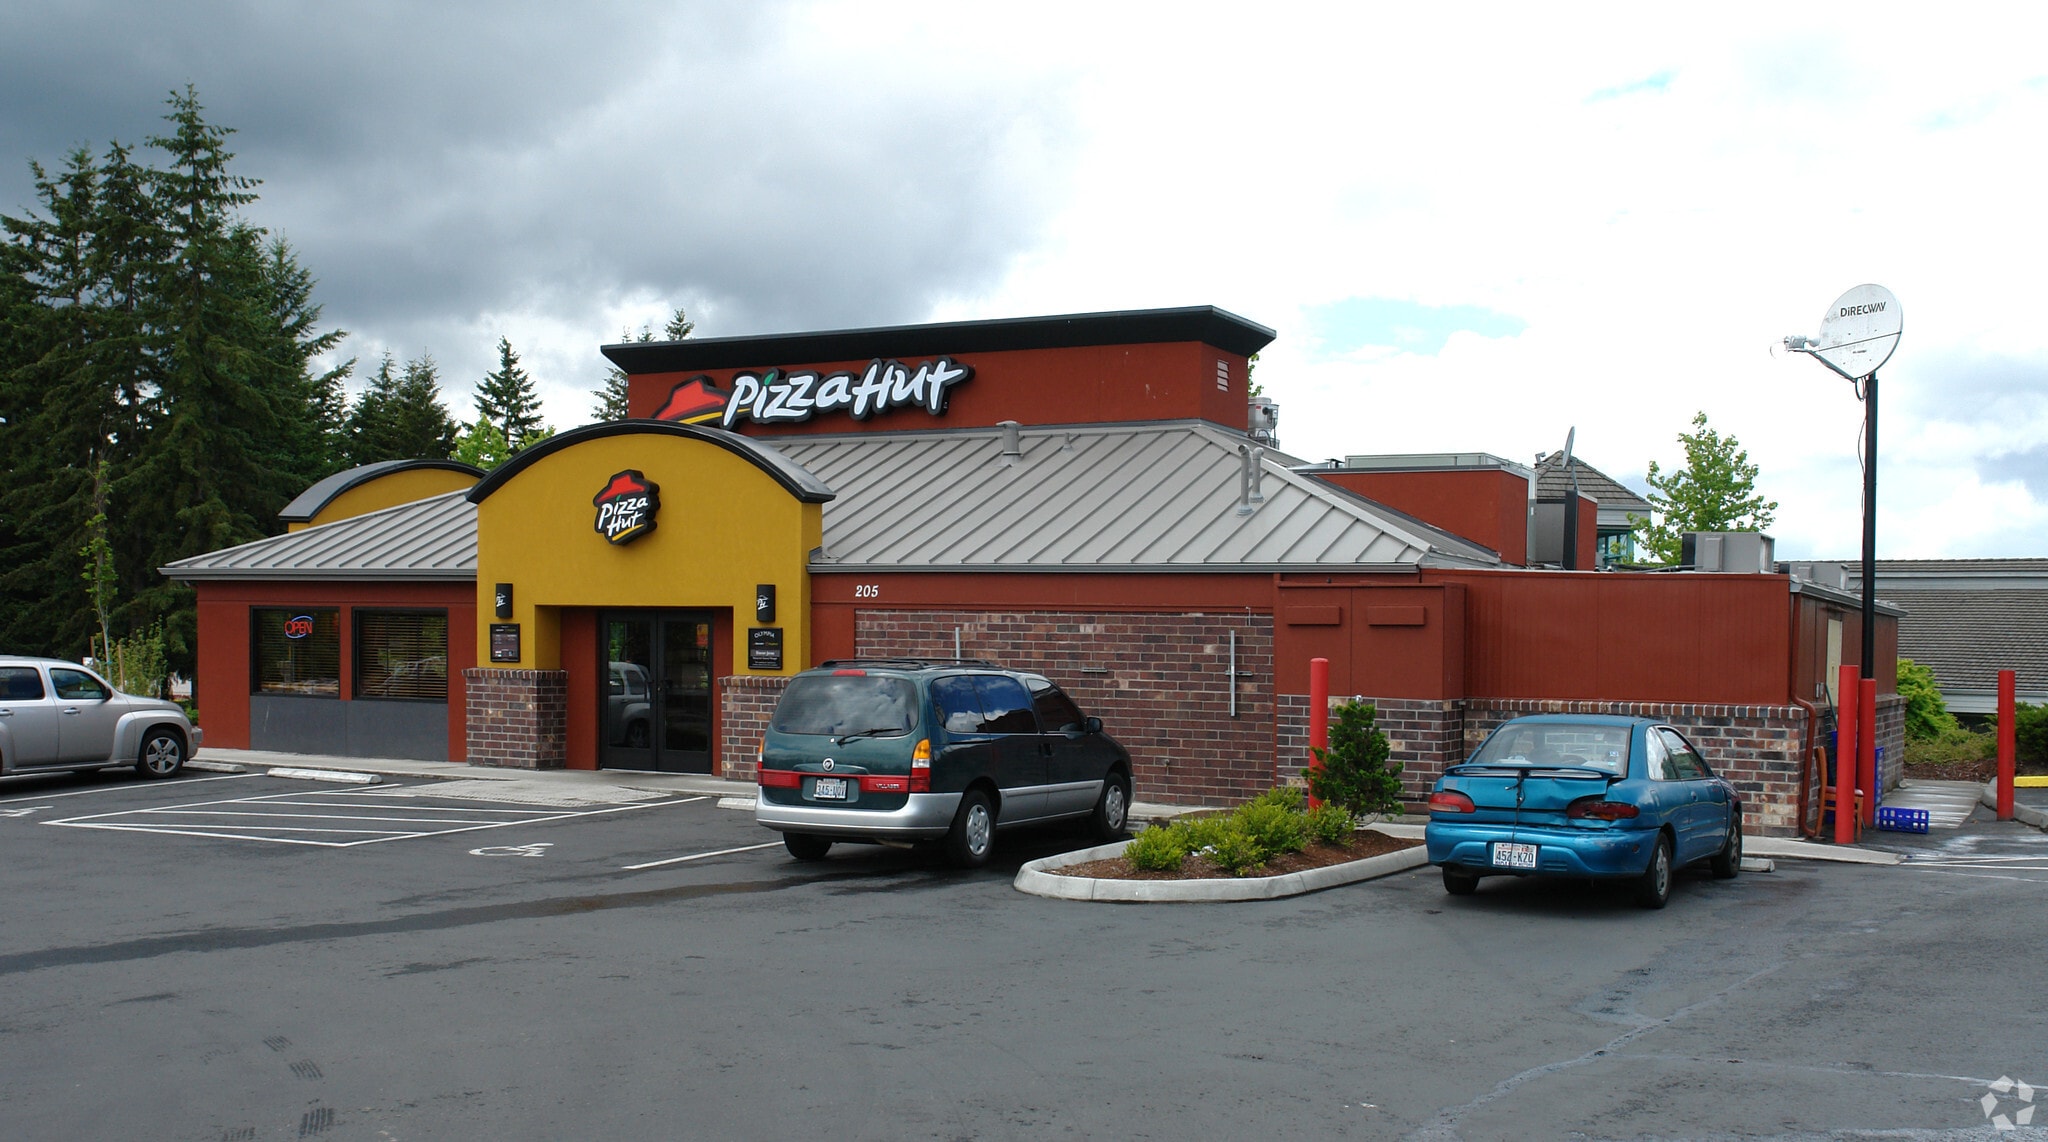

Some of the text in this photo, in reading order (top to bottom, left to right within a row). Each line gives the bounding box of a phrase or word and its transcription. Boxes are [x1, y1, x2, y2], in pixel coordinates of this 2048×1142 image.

[723, 361, 964, 427] Pizza Hut
[598, 494, 649, 530] Pizza
[606, 511, 643, 536] Hut
[855, 584, 880, 598] 205
[284, 621, 313, 634] OPEN
[754, 630, 775, 638] OLYMPIA
